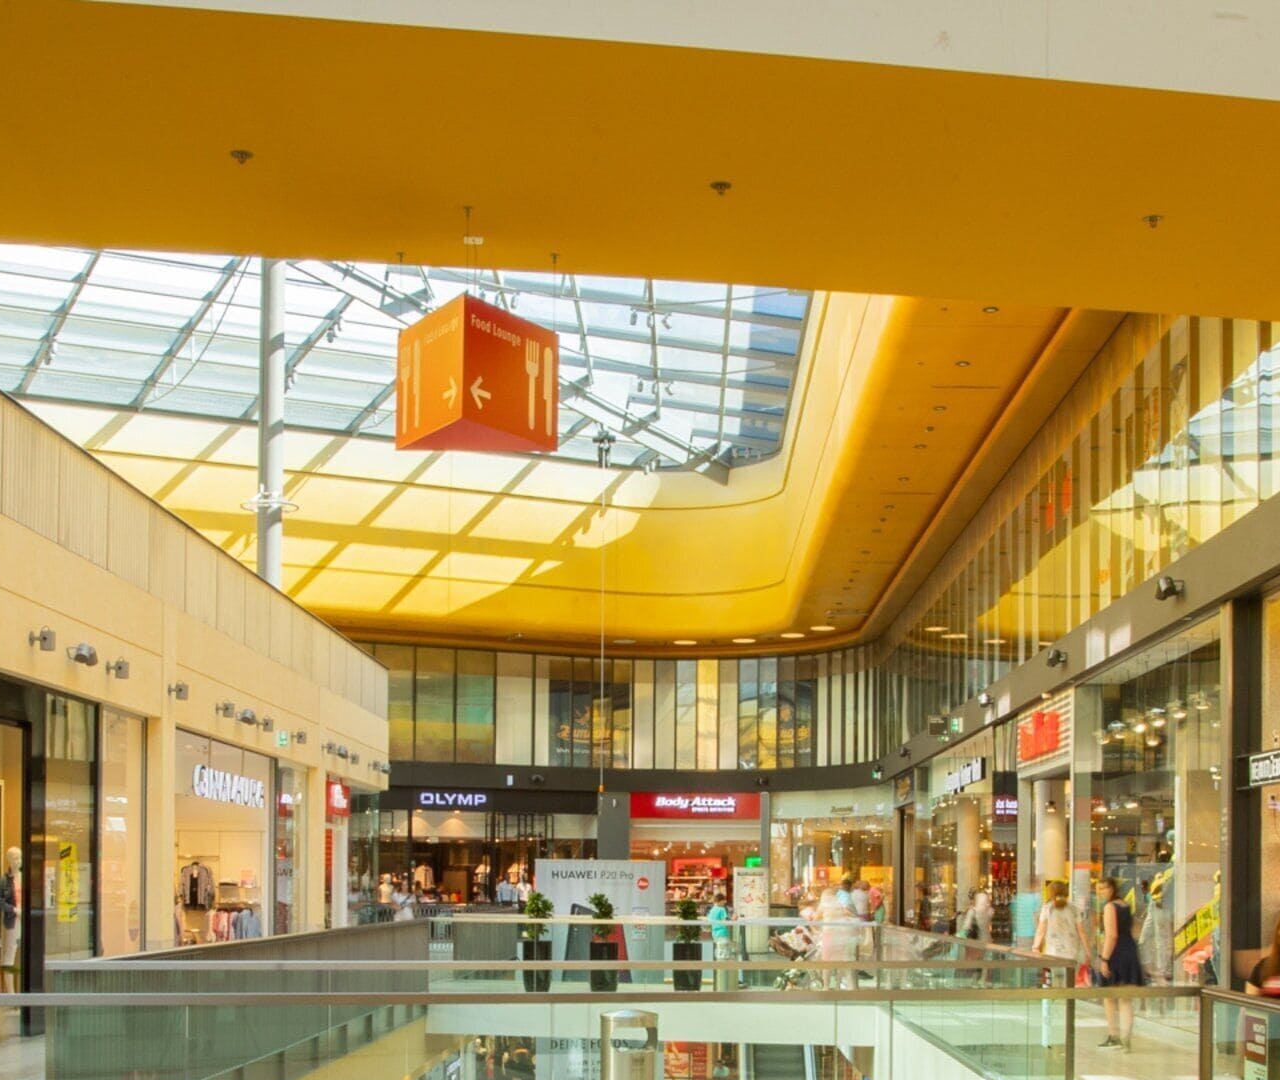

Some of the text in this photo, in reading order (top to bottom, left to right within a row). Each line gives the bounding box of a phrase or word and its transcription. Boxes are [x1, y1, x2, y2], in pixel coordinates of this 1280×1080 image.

[470, 313, 522, 348] Food Lounge
[420, 792, 487, 807] OLYMP
[655, 796, 736, 809] Body Attack
[551, 870, 635, 880] HUAWEI P20 Pro
[550, 1039, 587, 1050] DEINE
